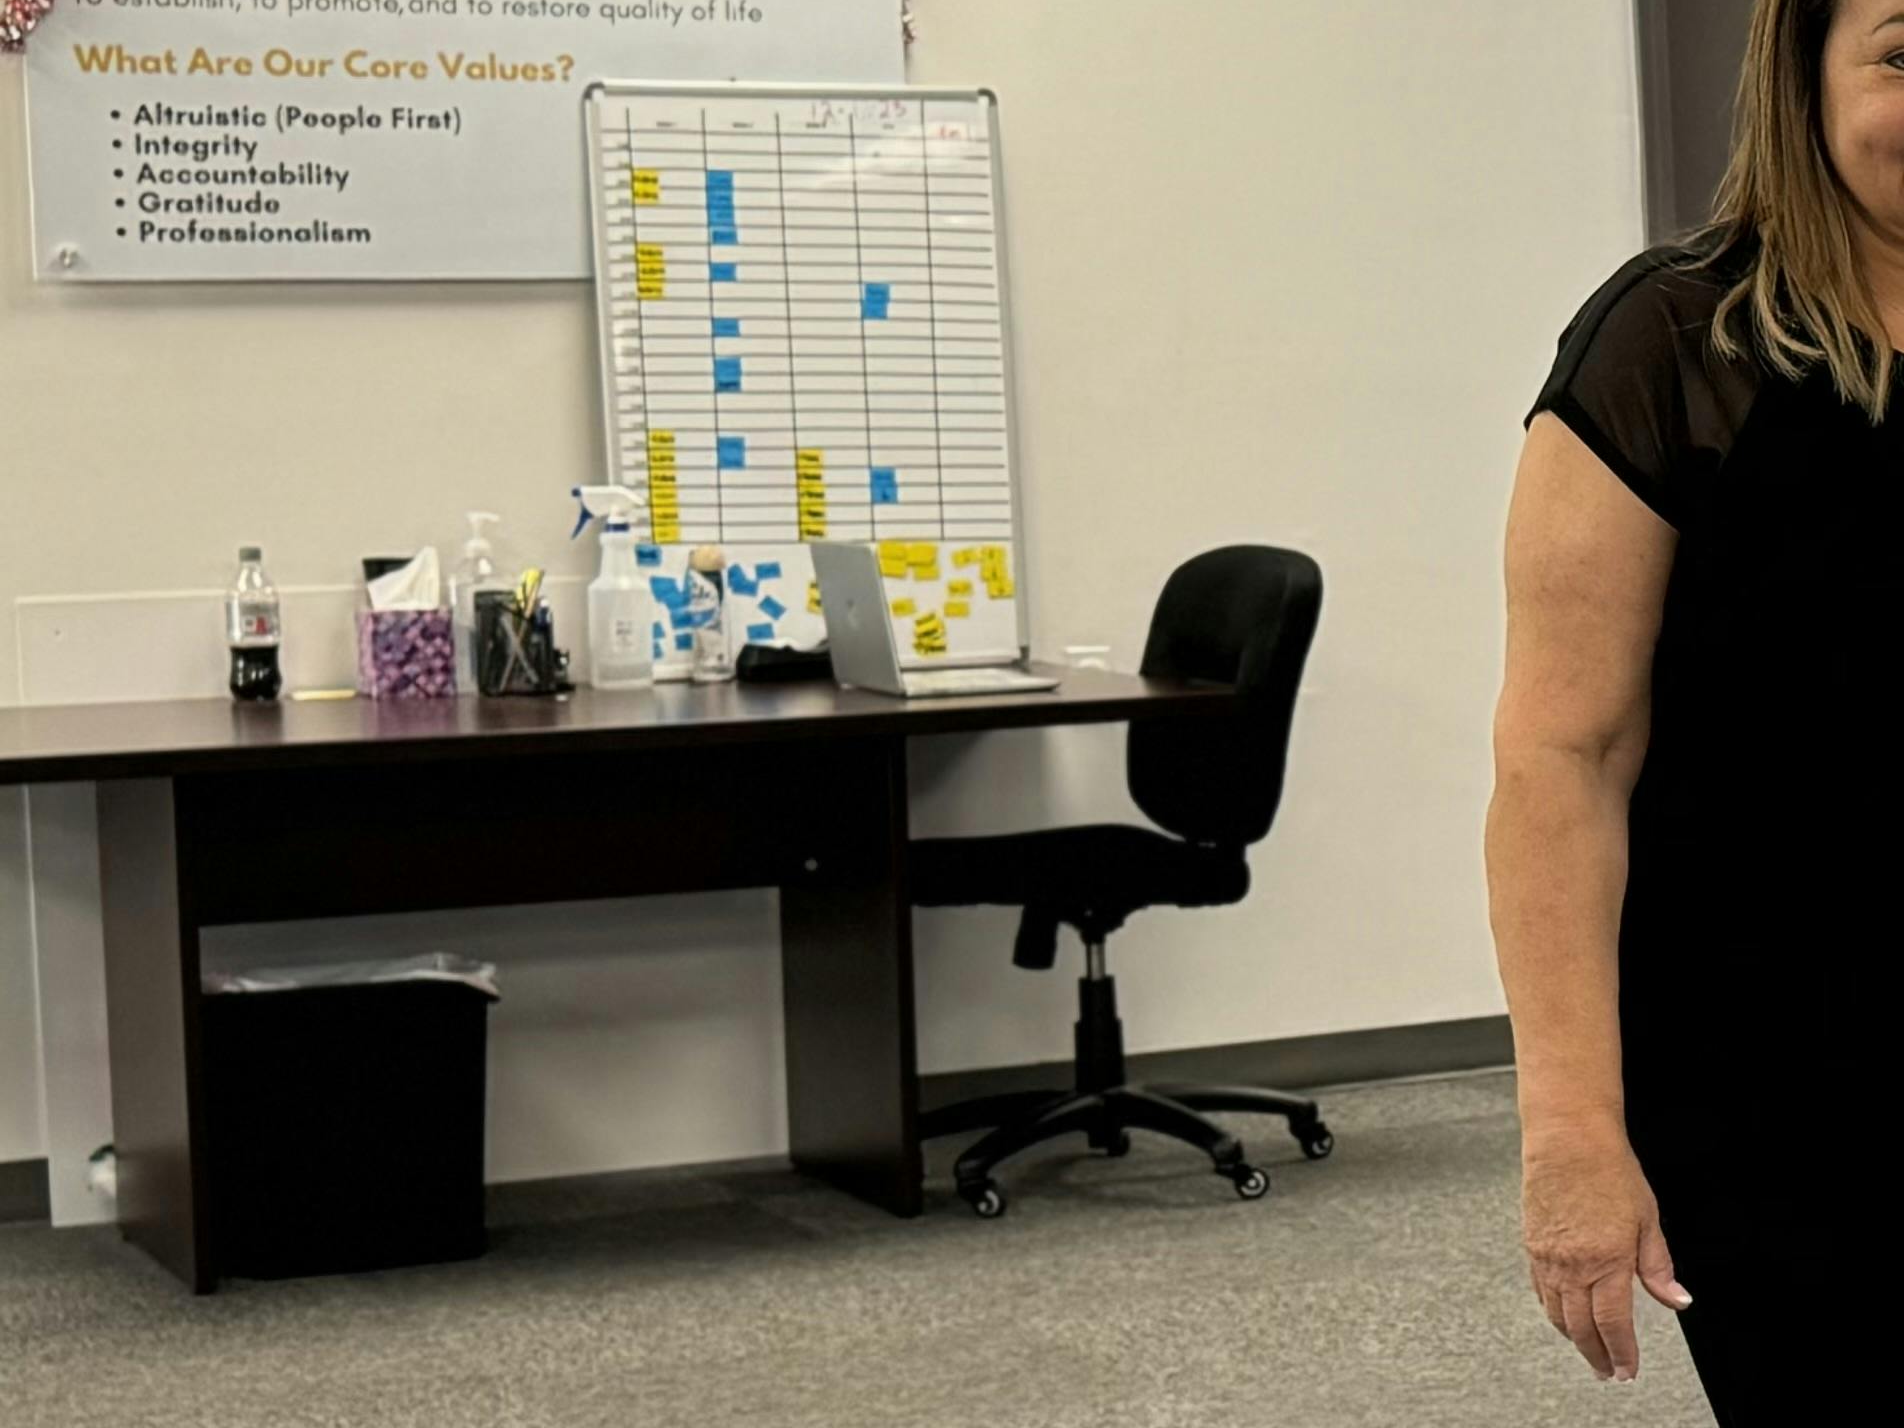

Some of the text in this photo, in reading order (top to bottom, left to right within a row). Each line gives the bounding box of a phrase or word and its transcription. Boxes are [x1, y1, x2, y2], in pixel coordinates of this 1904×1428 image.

[725, 0, 763, 24] life
[73, 43, 575, 83] What Are Our Core Values?
[133, 102, 462, 135] Altruistic (People First)
[134, 134, 258, 163] Integrity
[136, 162, 350, 192] Accountability
[138, 190, 280, 215] Gratitude
[139, 220, 371, 244] Professionalism
